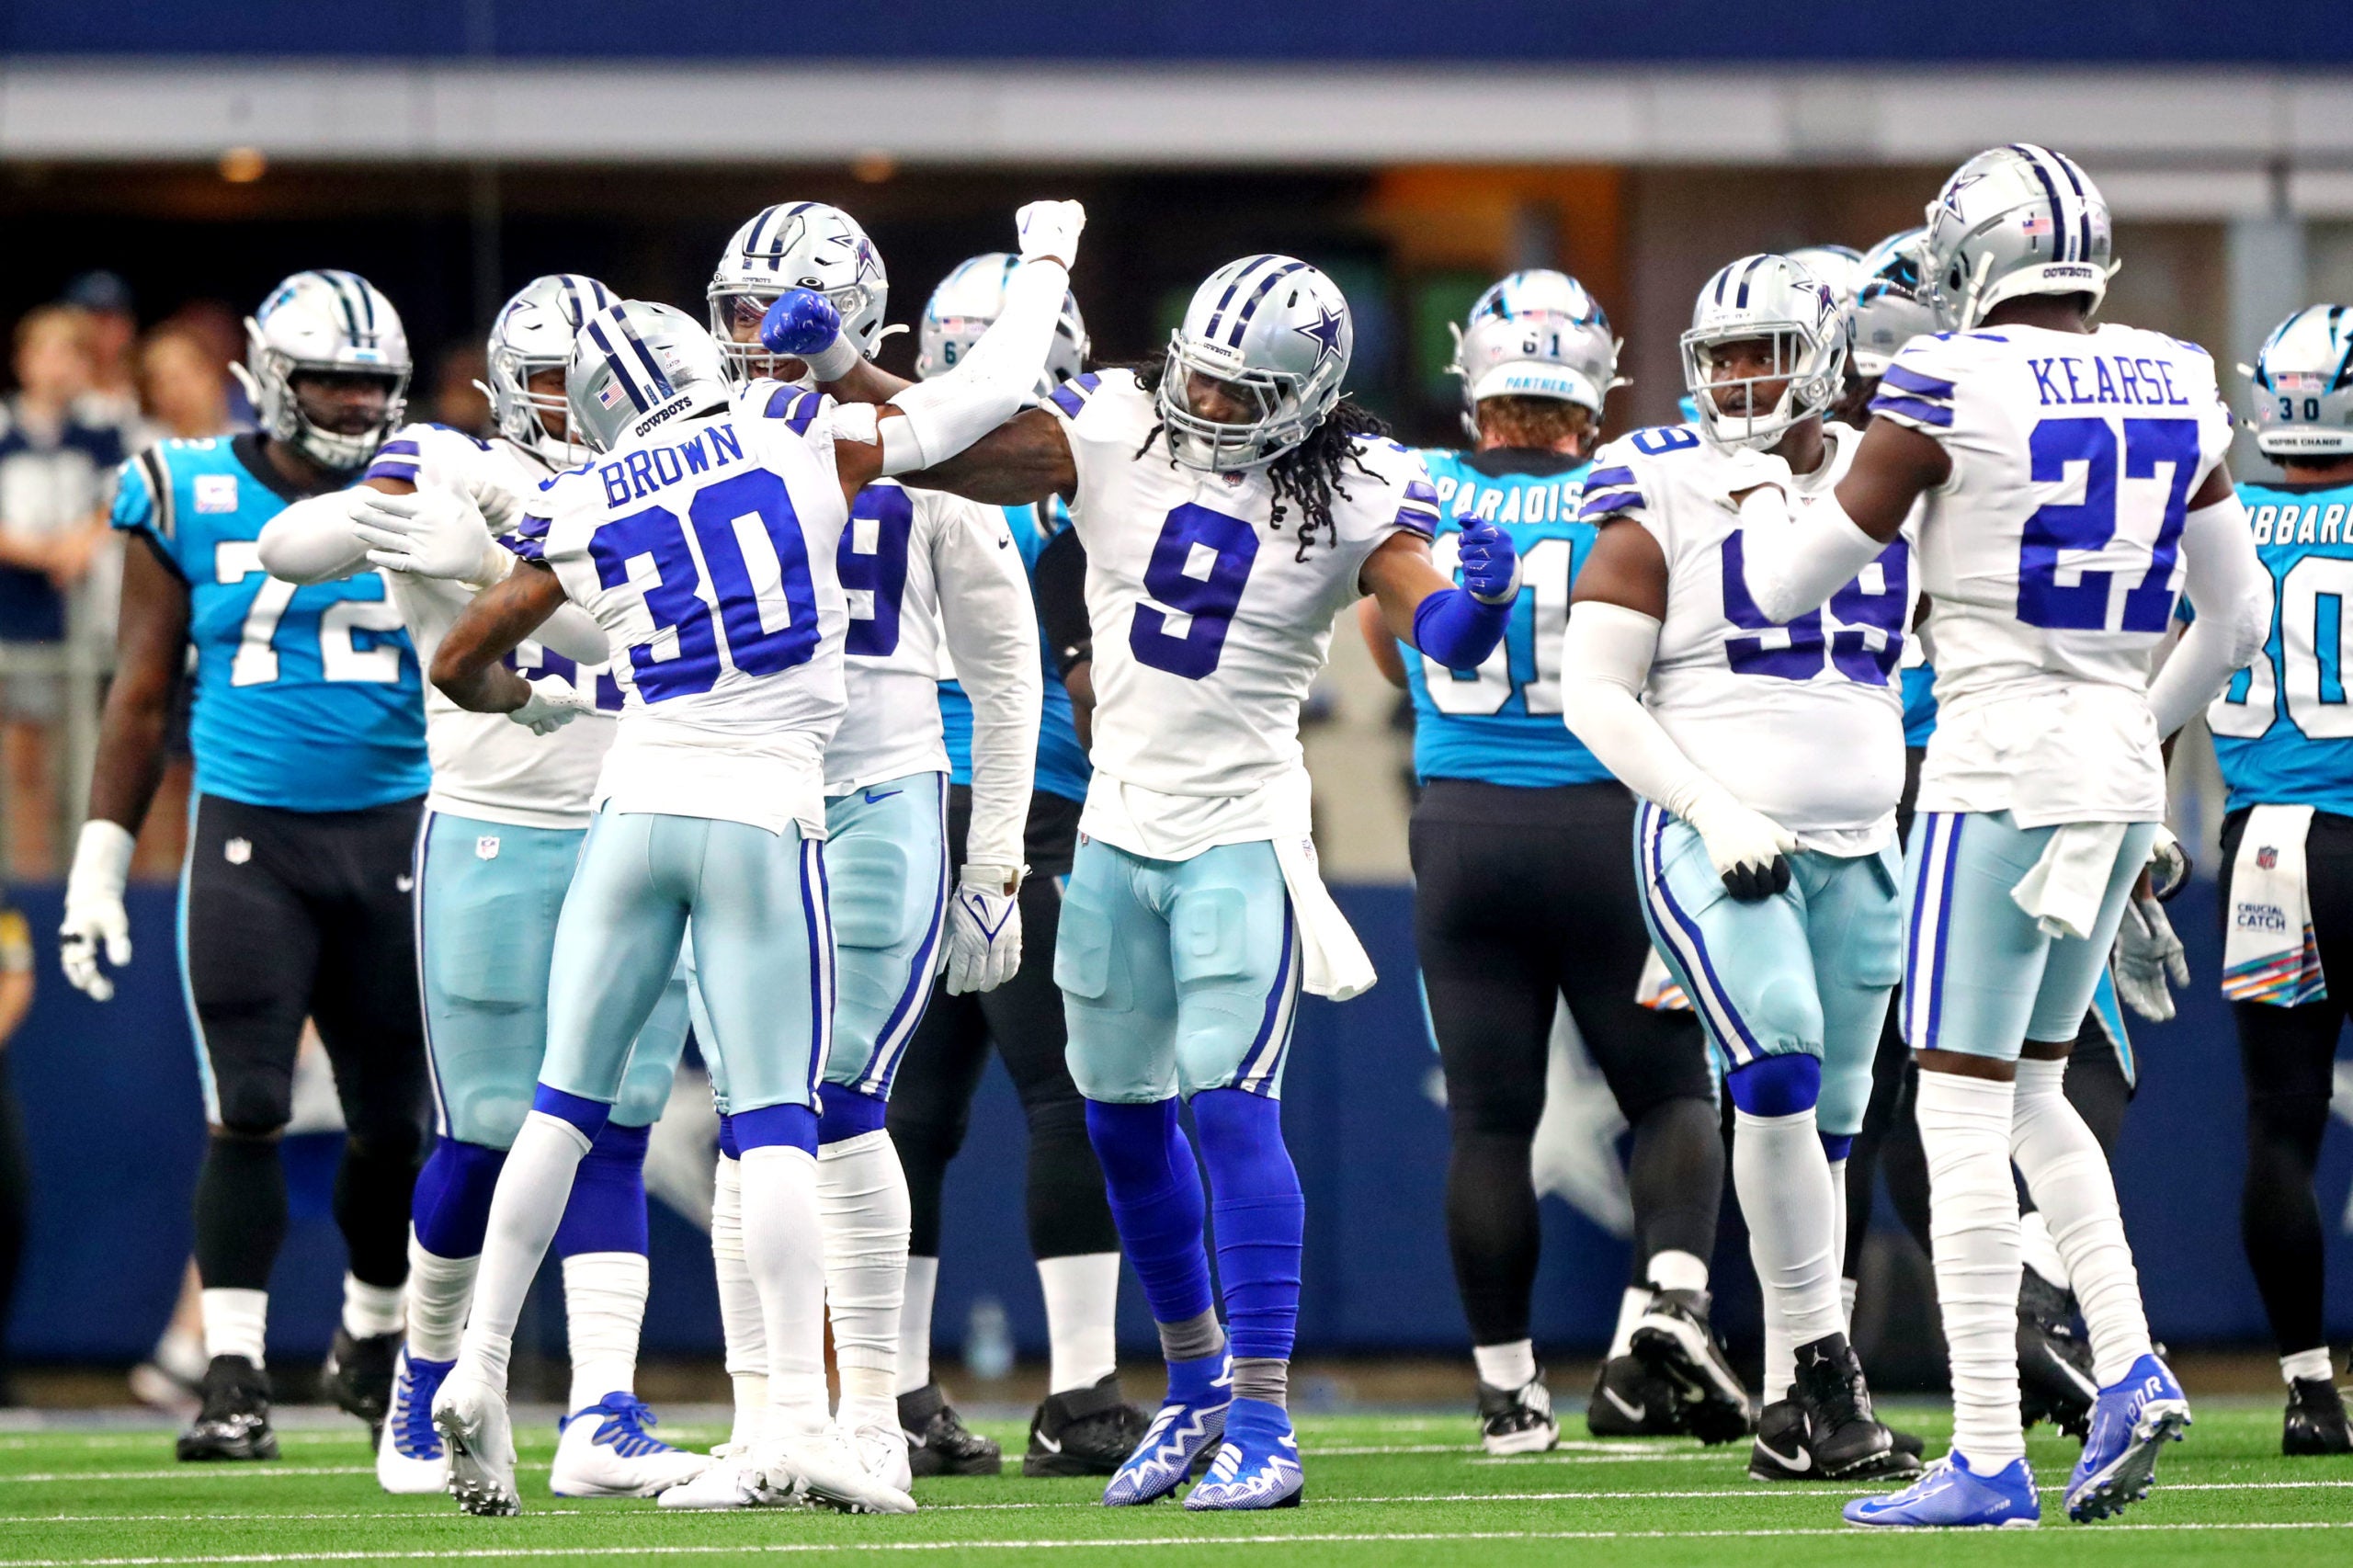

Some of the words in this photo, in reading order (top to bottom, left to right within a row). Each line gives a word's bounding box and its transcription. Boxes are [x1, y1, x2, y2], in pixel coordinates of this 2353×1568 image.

[1505, 376, 1575, 394] PANTHERS
[2027, 355, 2189, 405] KEARSE
[634, 395, 694, 438] COWBOYS
[2279, 396, 2321, 422] 30
[597, 423, 745, 509] BROWN
[1437, 476, 1586, 524] PARADIS
[2016, 416, 2200, 633] 27
[2246, 504, 2353, 546] BBAR
[587, 466, 823, 705] 30
[1128, 501, 1261, 681] 9
[1721, 528, 1911, 687] 99
[216, 540, 406, 687] 72
[2237, 903, 2282, 916] CRUCIAL
[2237, 914, 2286, 930] CATCH
